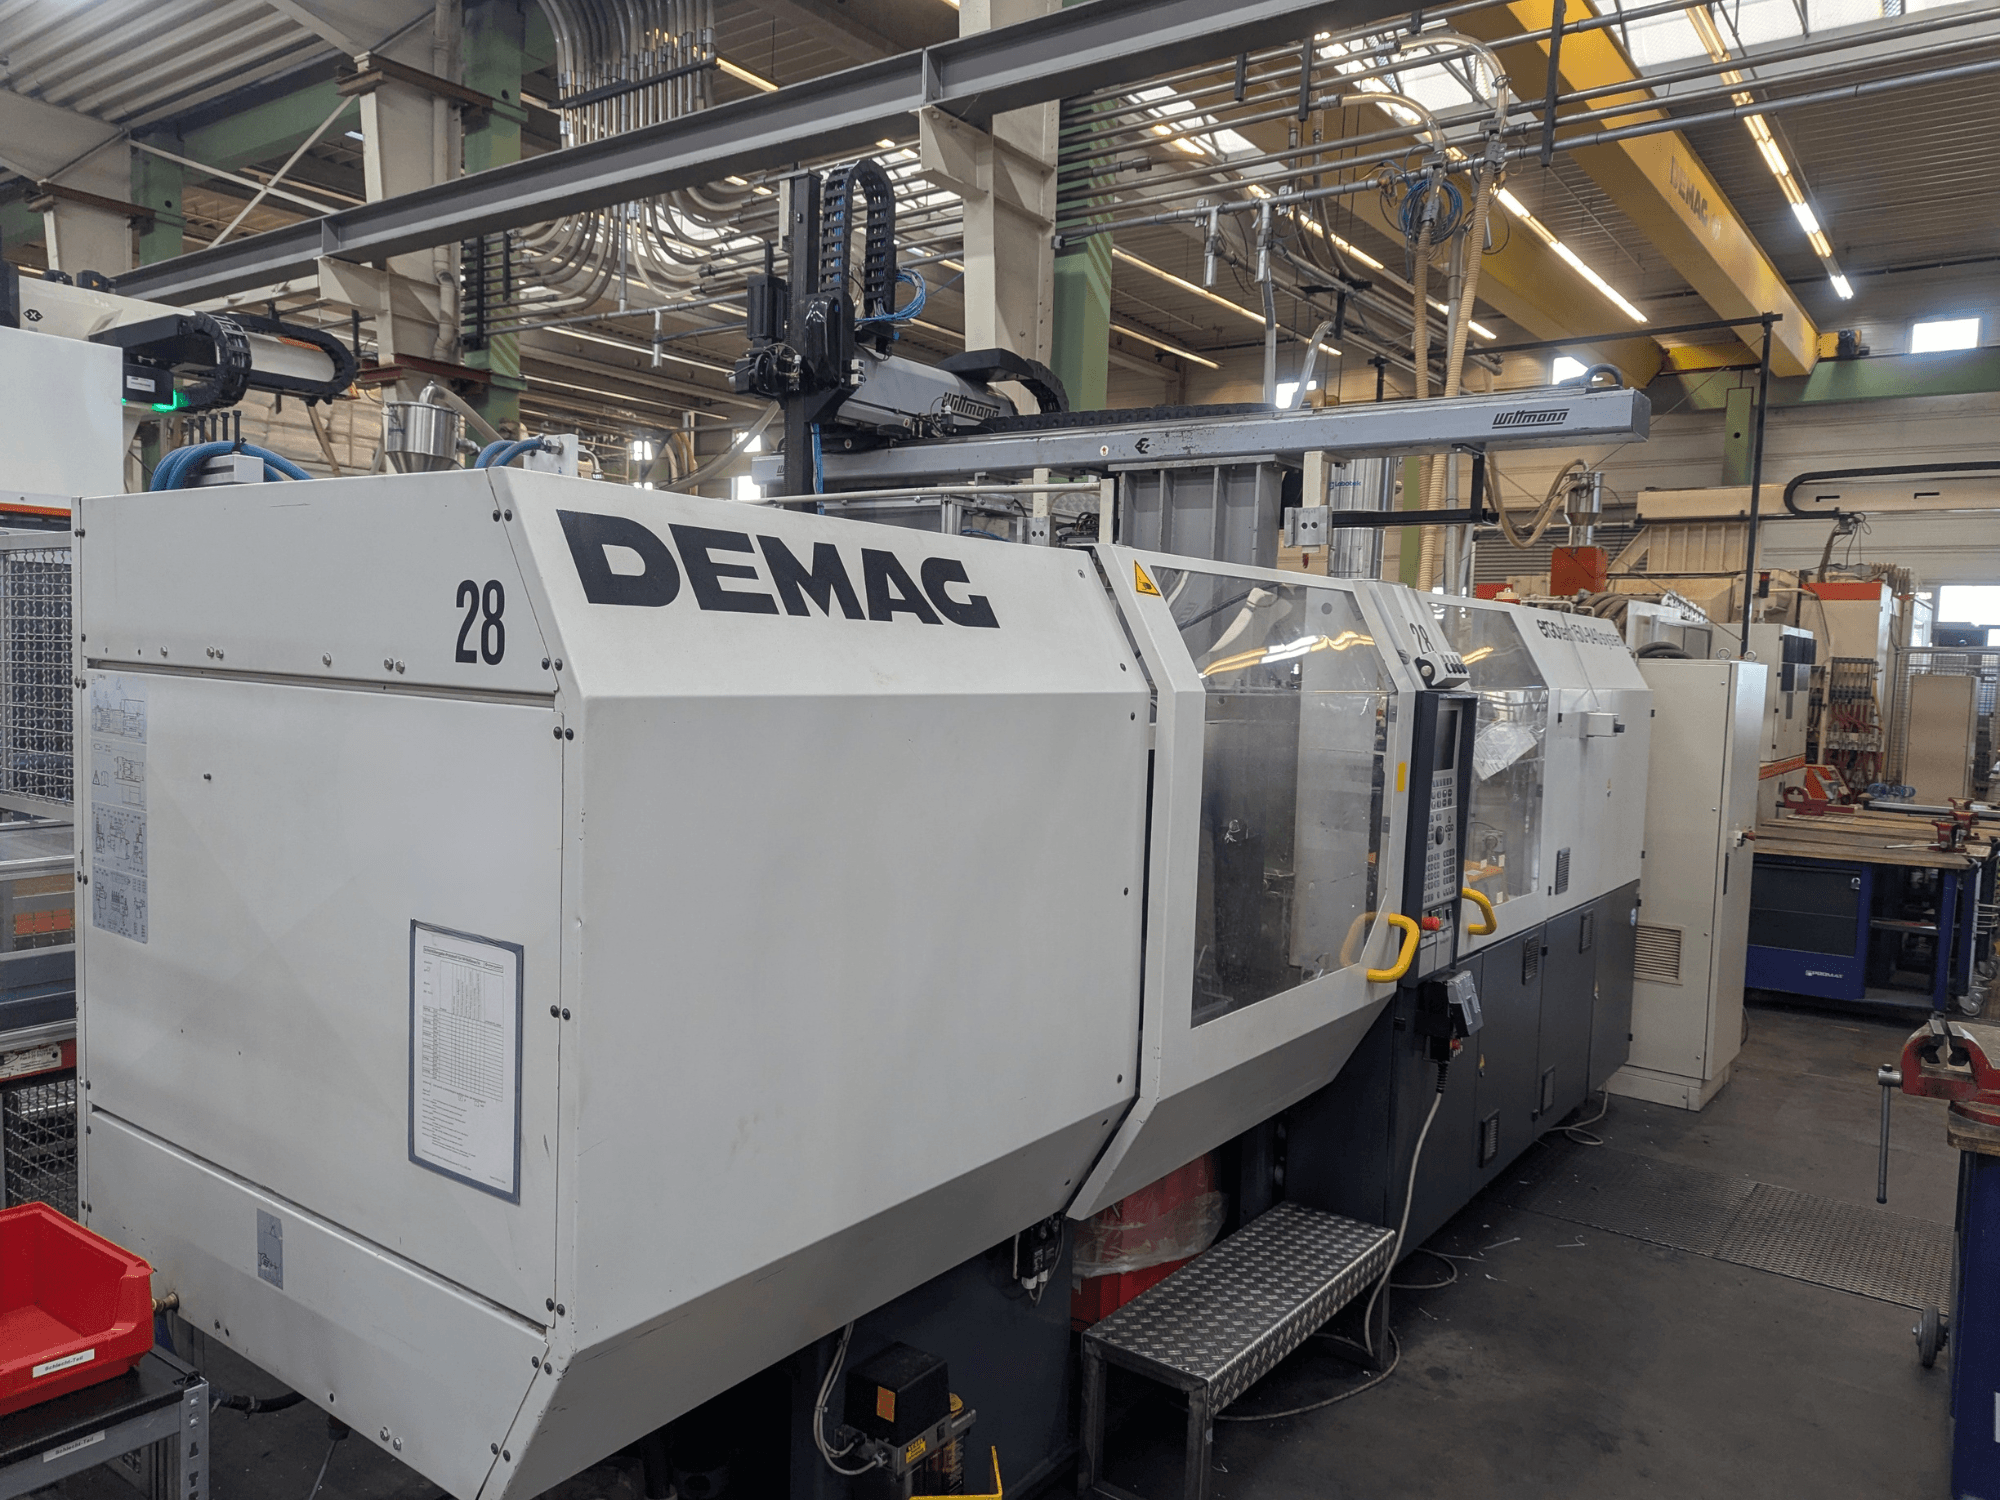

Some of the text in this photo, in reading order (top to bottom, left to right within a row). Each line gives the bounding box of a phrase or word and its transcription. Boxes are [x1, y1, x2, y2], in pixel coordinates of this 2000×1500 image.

[1492, 408, 1570, 429] Wittmann
[556, 508, 1000, 628] DEMAG
[455, 579, 506, 666] 28
[1409, 622, 1436, 655] 28
[45, 1355, 84, 1371] Schlecht-Teil
[56, 1437, 94, 1455] Schlecht-Teil
